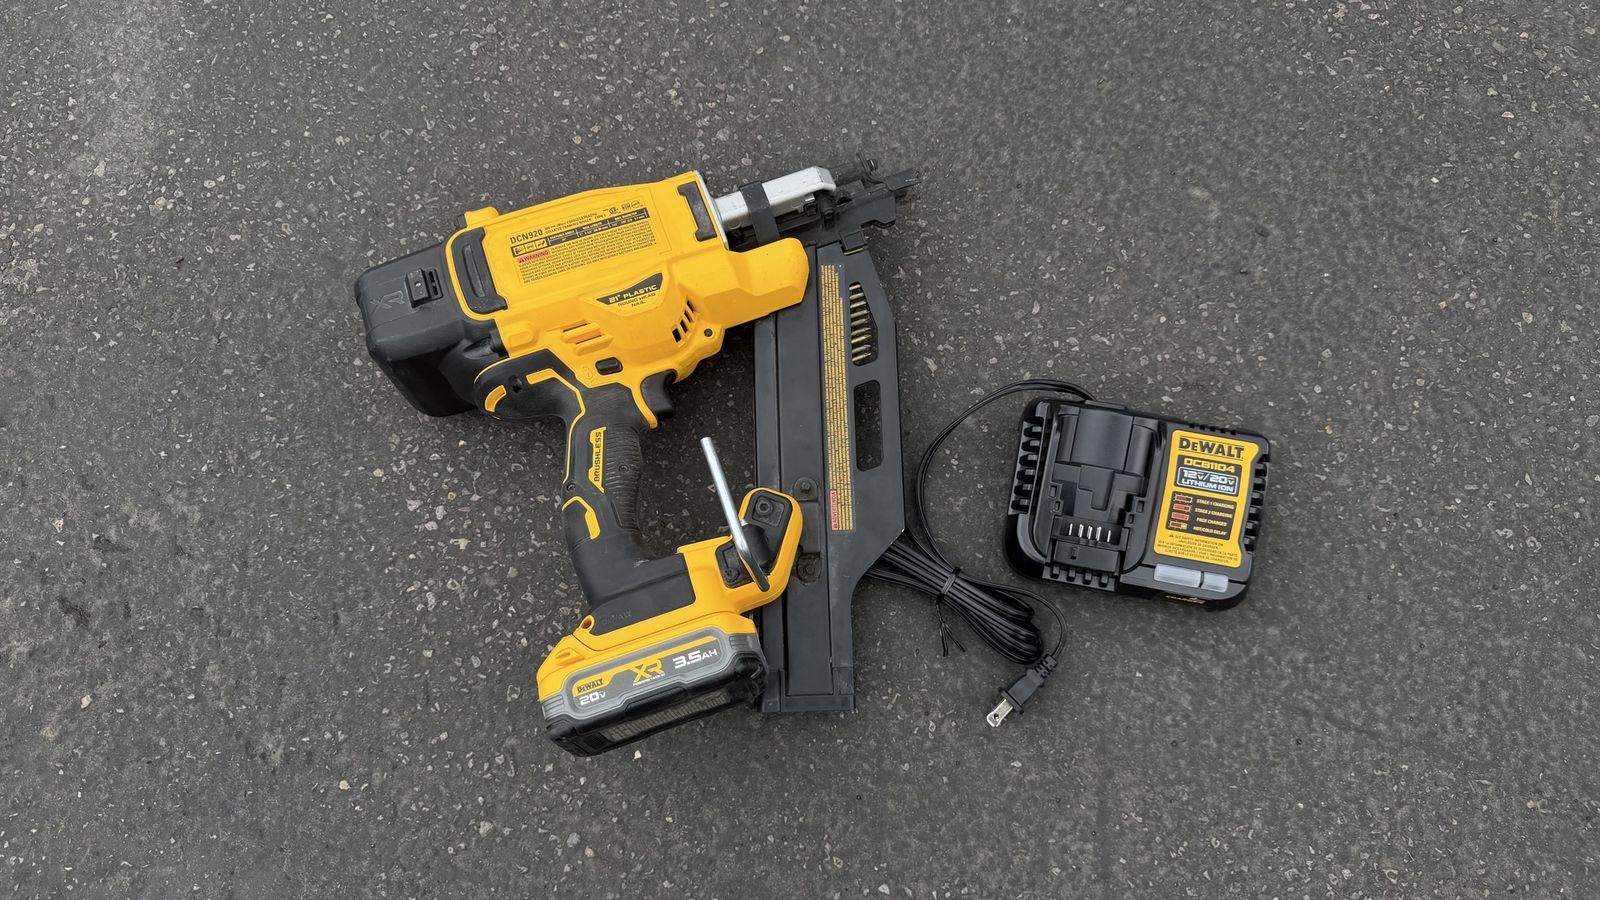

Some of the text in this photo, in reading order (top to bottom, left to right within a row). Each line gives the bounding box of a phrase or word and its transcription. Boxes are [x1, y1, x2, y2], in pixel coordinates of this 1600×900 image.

[510, 229, 543, 244] DCN920
[523, 250, 549, 262] WARNING
[623, 284, 657, 299] PLASTIC
[369, 290, 405, 313] XR
[617, 292, 656, 307] ROUND HEAD
[594, 432, 602, 482] BRUSHLESS
[1183, 457, 1235, 473] DCB1104
[1181, 478, 1234, 492] LITHIUM ION
[1196, 498, 1210, 506] STAGE
[1213, 501, 1235, 510] CHARGING
[1194, 507, 1208, 515] STAGE
[1211, 510, 1233, 519] CHARGING
[1207, 518, 1227, 527] CHARGED
[1213, 528, 1227, 536] DELAY
[628, 658, 664, 684] XR
